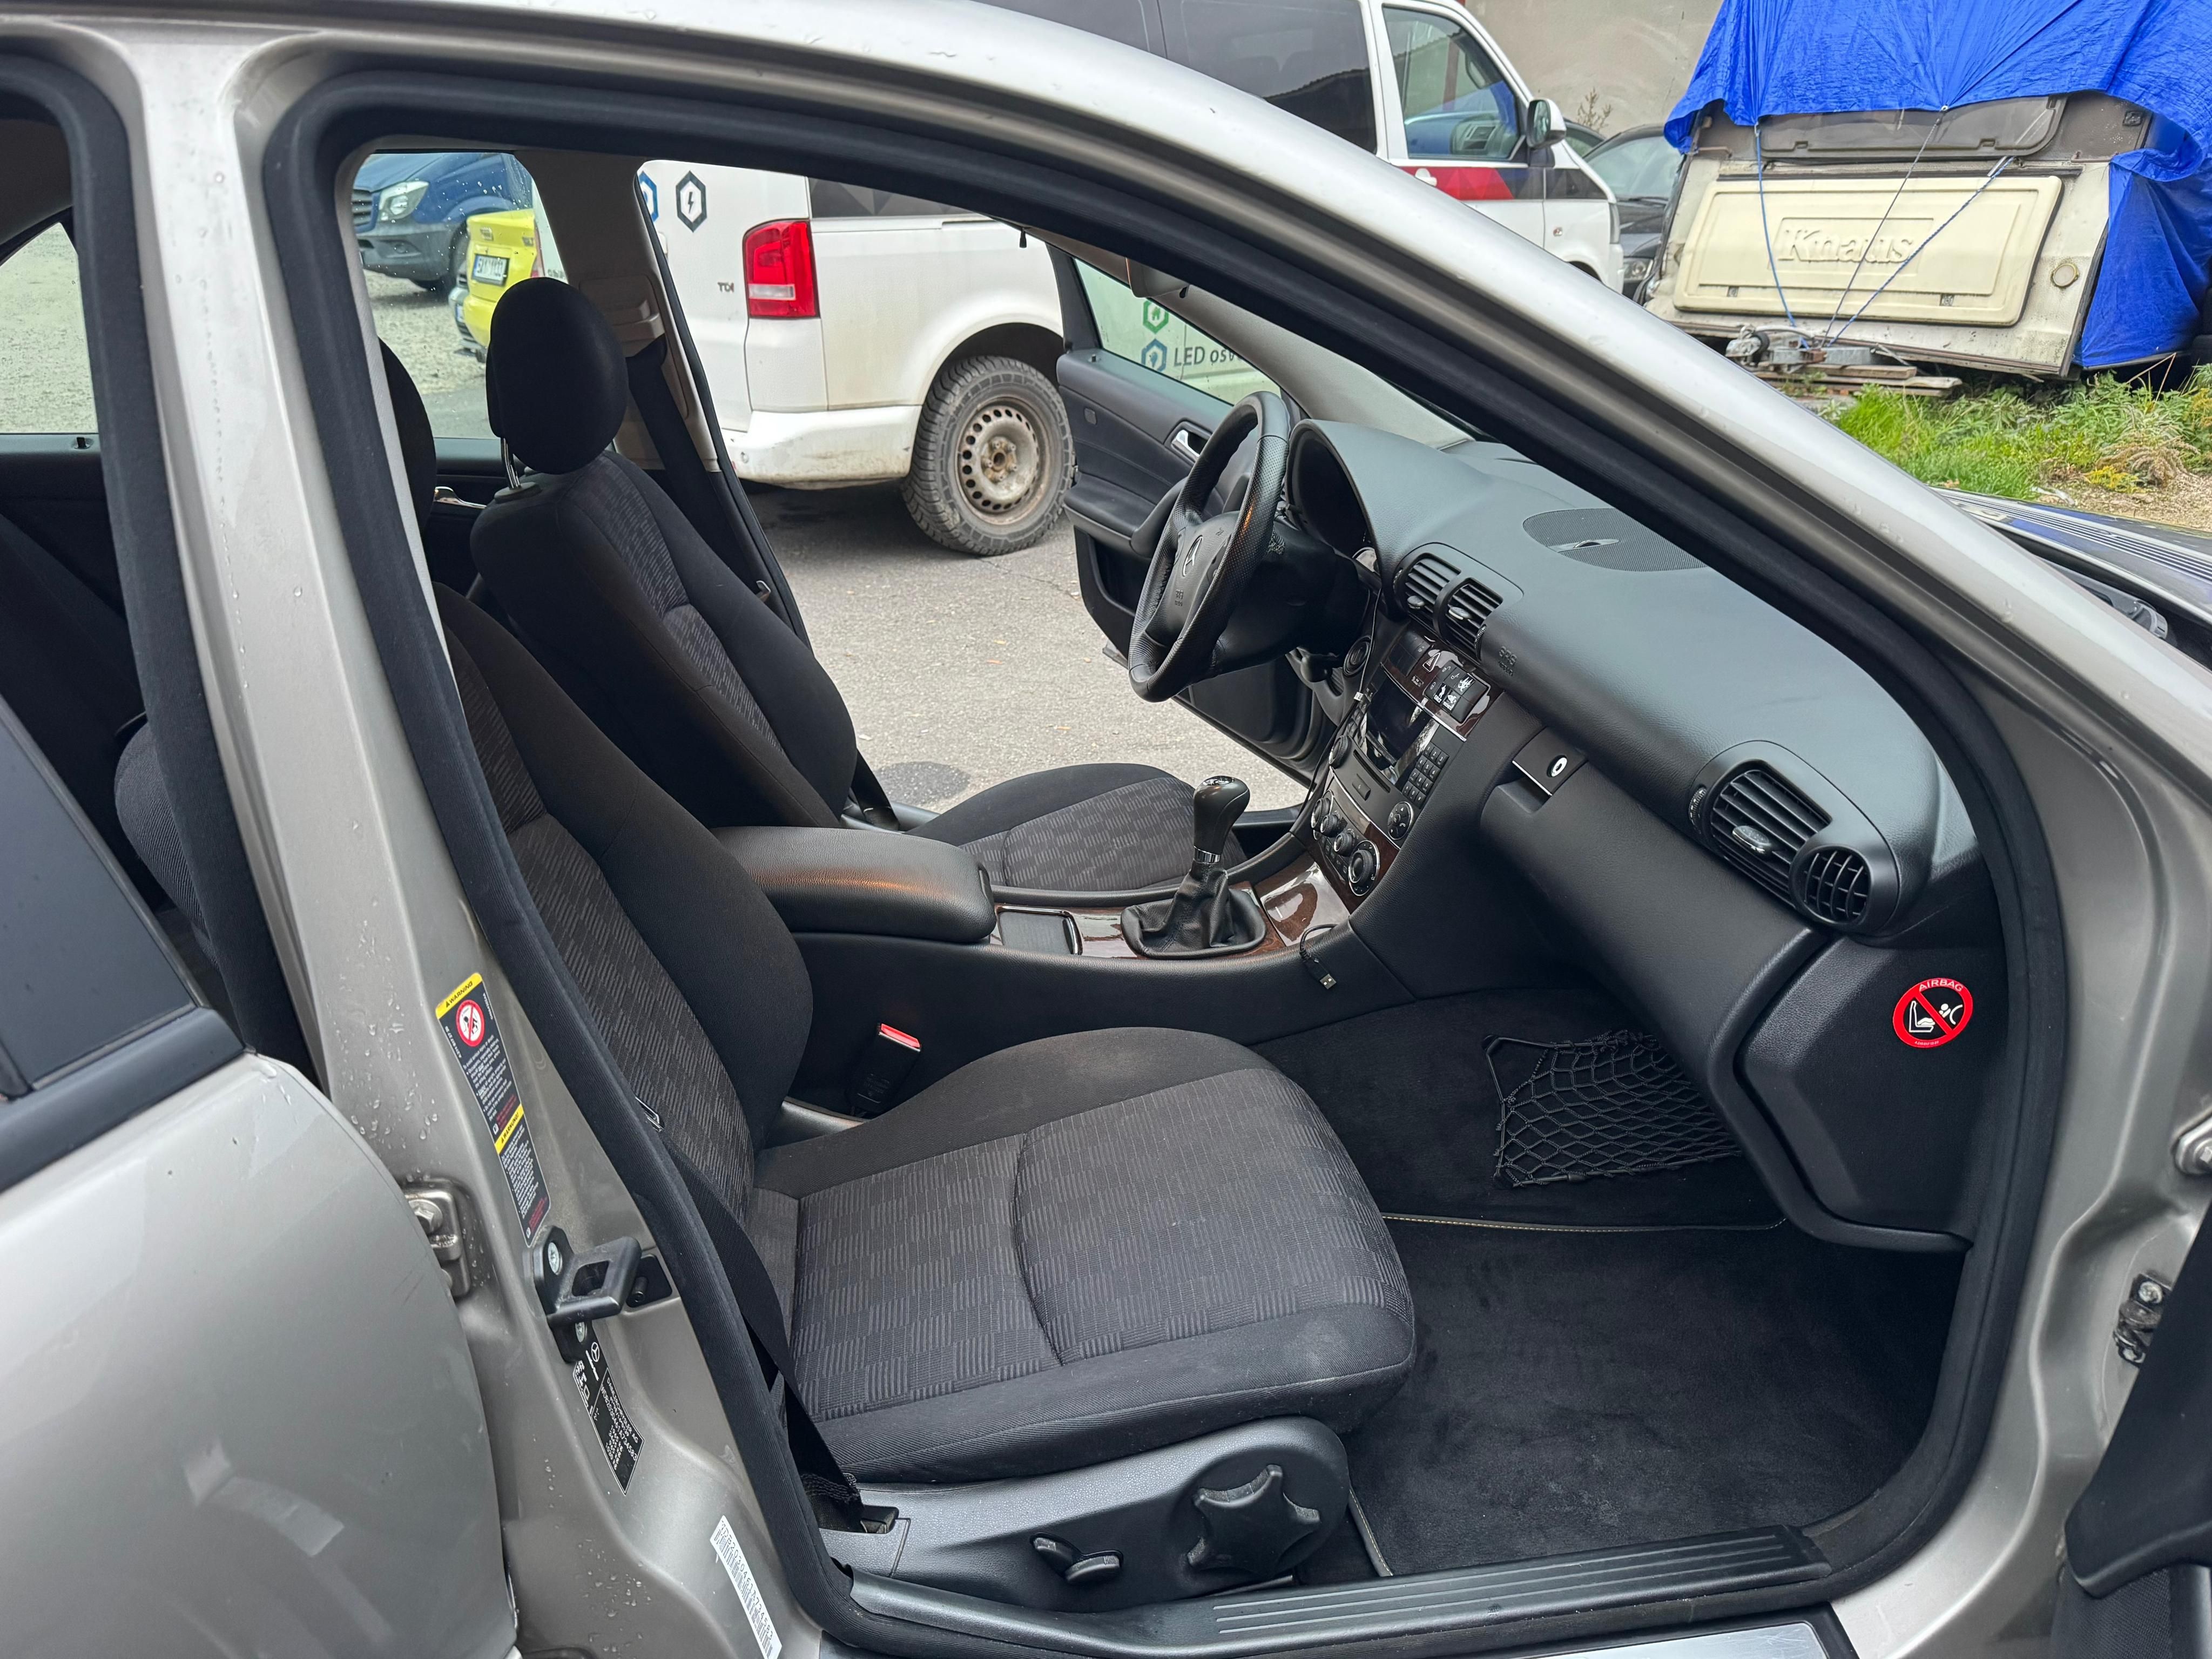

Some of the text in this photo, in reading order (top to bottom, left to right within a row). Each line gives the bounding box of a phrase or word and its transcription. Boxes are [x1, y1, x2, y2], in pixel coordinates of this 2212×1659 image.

[1778, 230, 1913, 264] Knaus
[717, 282, 734, 292] TDI
[1174, 346, 1240, 367] LED osv
[449, 981, 473, 1003] WARNING
[1919, 979, 1963, 992] AIRBAG
[606, 1377, 638, 1443] DAIMLERCHRYSLER AG
